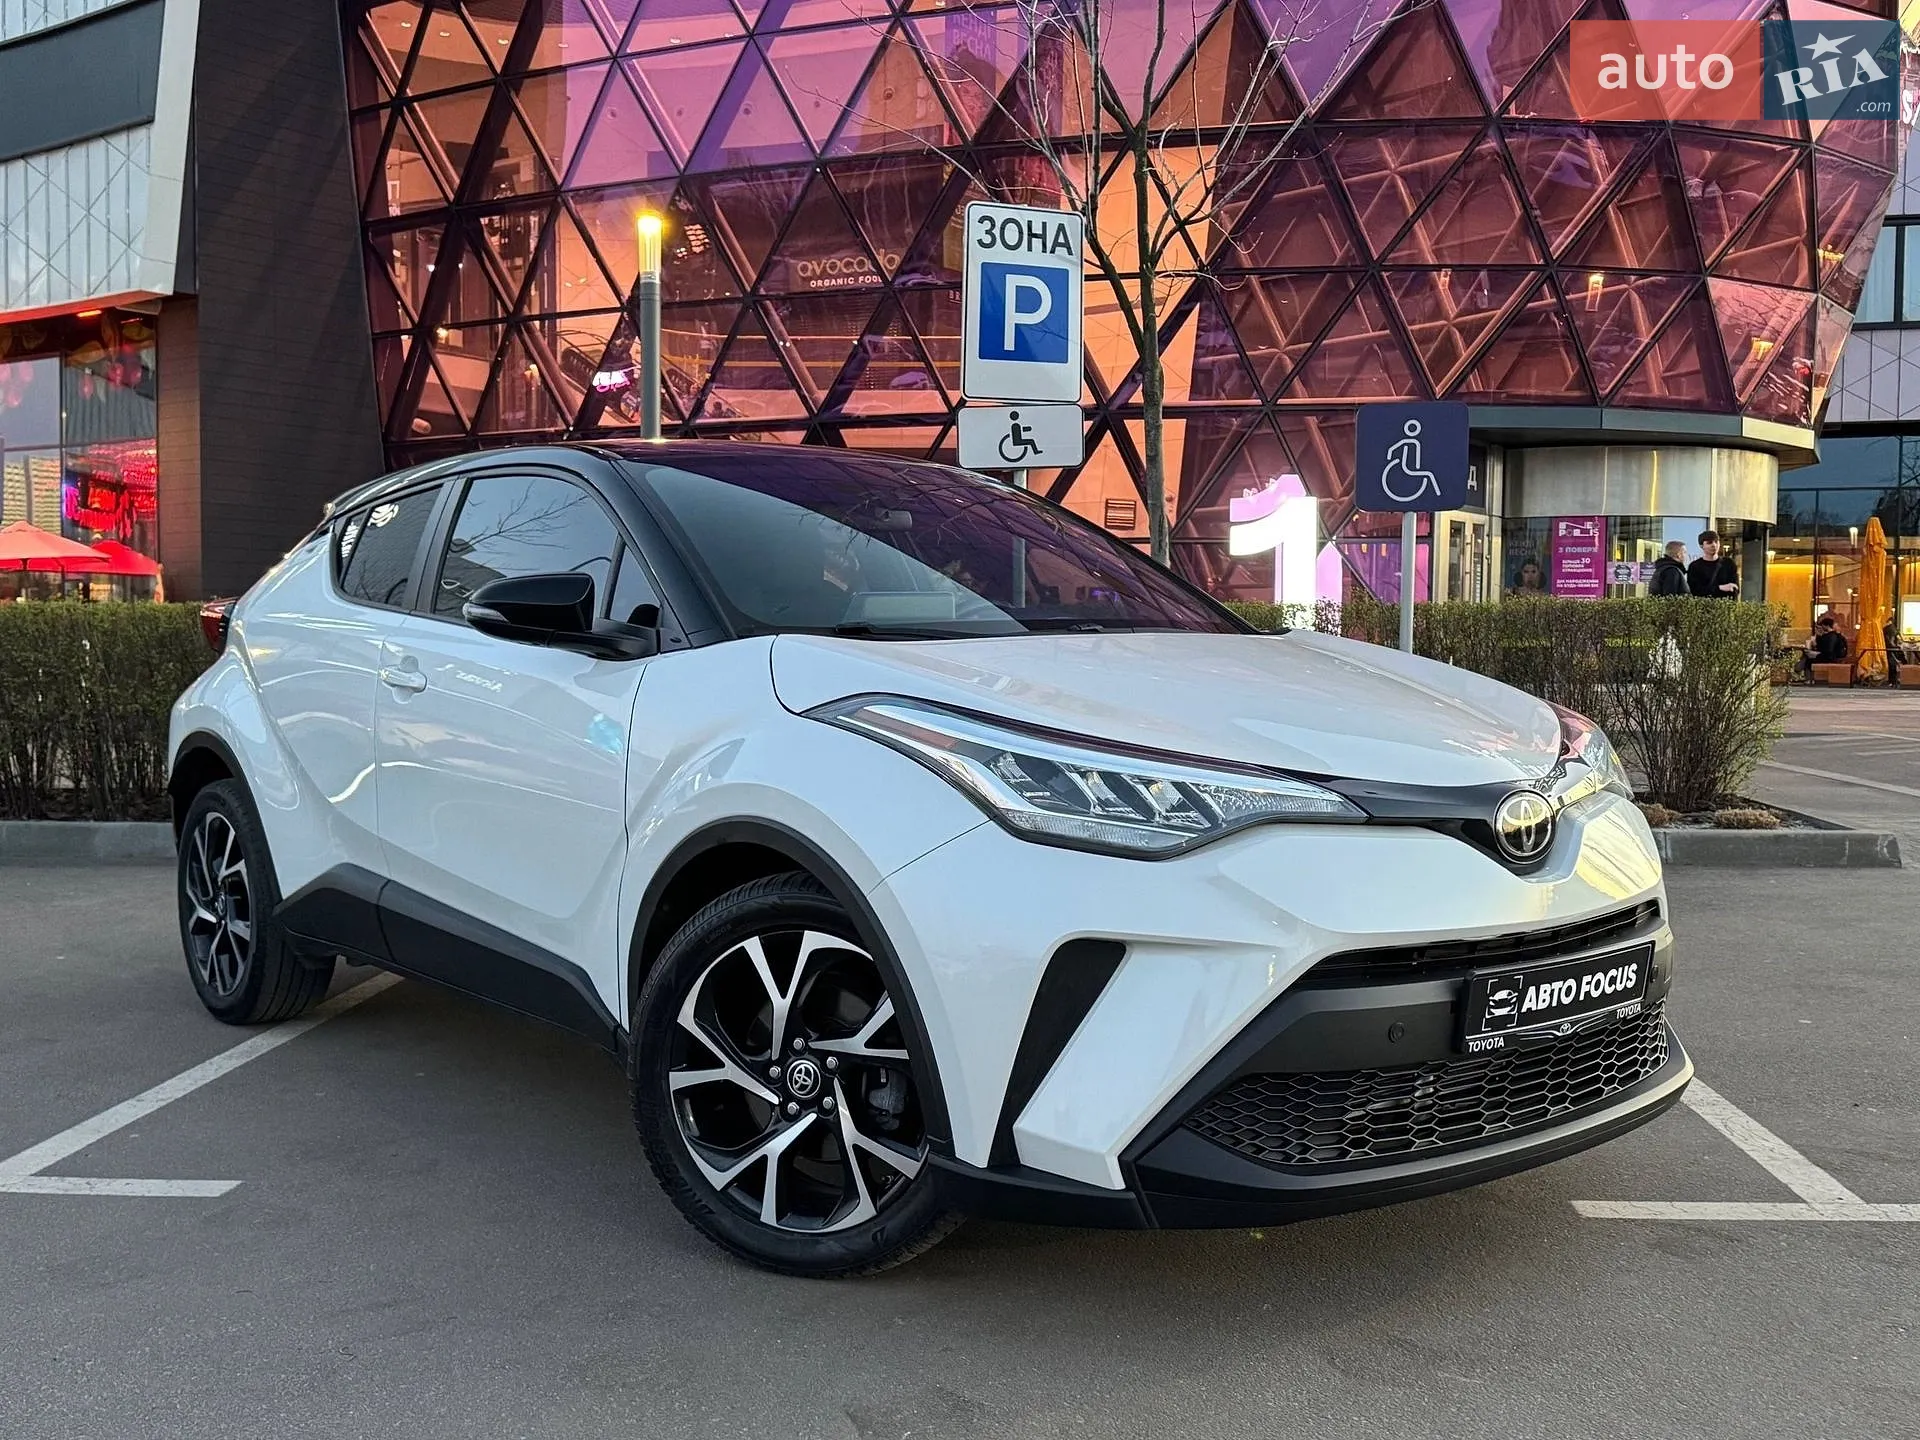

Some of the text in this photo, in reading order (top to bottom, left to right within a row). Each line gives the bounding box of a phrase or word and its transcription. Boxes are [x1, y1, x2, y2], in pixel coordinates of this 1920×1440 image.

[976, 215, 1074, 256] ЗОНА
[810, 277, 855, 288] ORGANIC
[1003, 274, 1053, 351] P
[1579, 963, 1638, 1001] FOCUS
[1616, 1002, 1641, 1019] TOYOTA
[1468, 1036, 1505, 1053] TOYOTA
